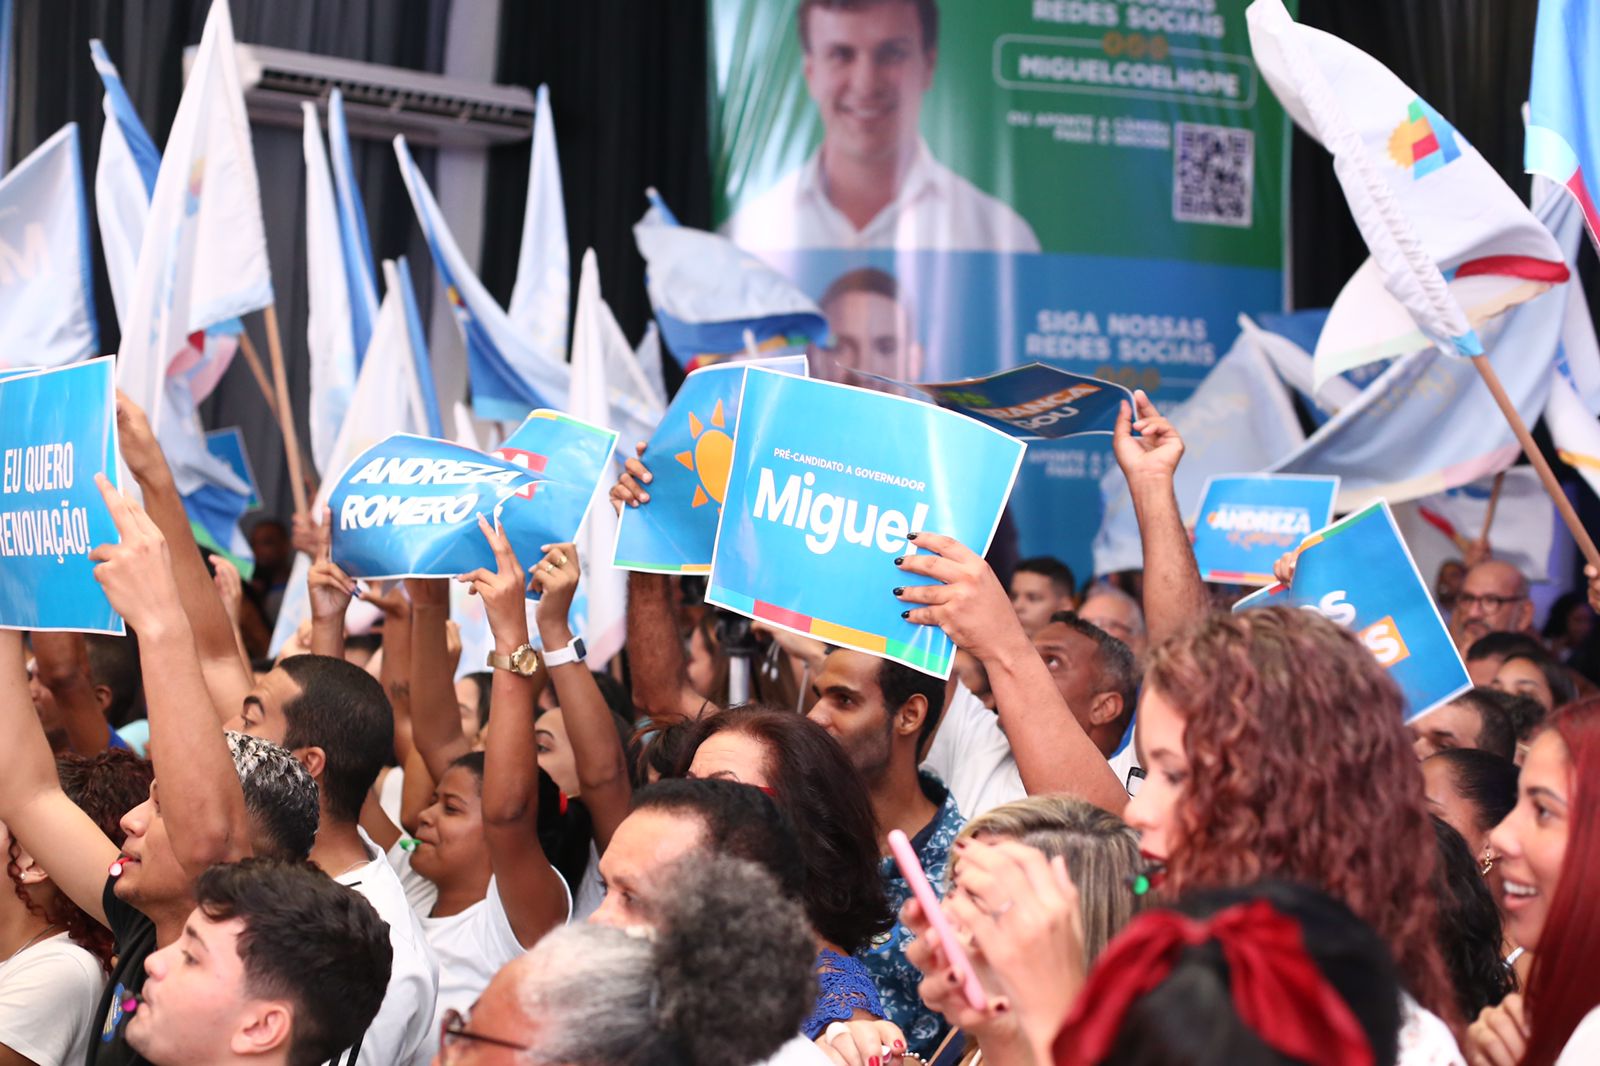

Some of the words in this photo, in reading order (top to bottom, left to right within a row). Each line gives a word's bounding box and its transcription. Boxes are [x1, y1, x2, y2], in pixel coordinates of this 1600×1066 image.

[1032, 0, 1119, 27] REDES
[1126, 4, 1225, 38] SOCIAIS
[1037, 310, 1099, 335] SIGA
[1108, 314, 1206, 342] NOSSAS
[1026, 335, 1111, 360] REDES
[1117, 338, 1215, 365] SOCIAIS
[4, 449, 22, 494] EU
[25, 442, 74, 494] QUERO
[349, 457, 524, 485] ANDREZA
[773, 447, 844, 473] PRÉ-CANDIDATO
[845, 463, 853, 475] A
[854, 466, 925, 492] GOVERNADOR
[340, 494, 479, 530] ROMERO
[753, 467, 929, 556] Miguel
